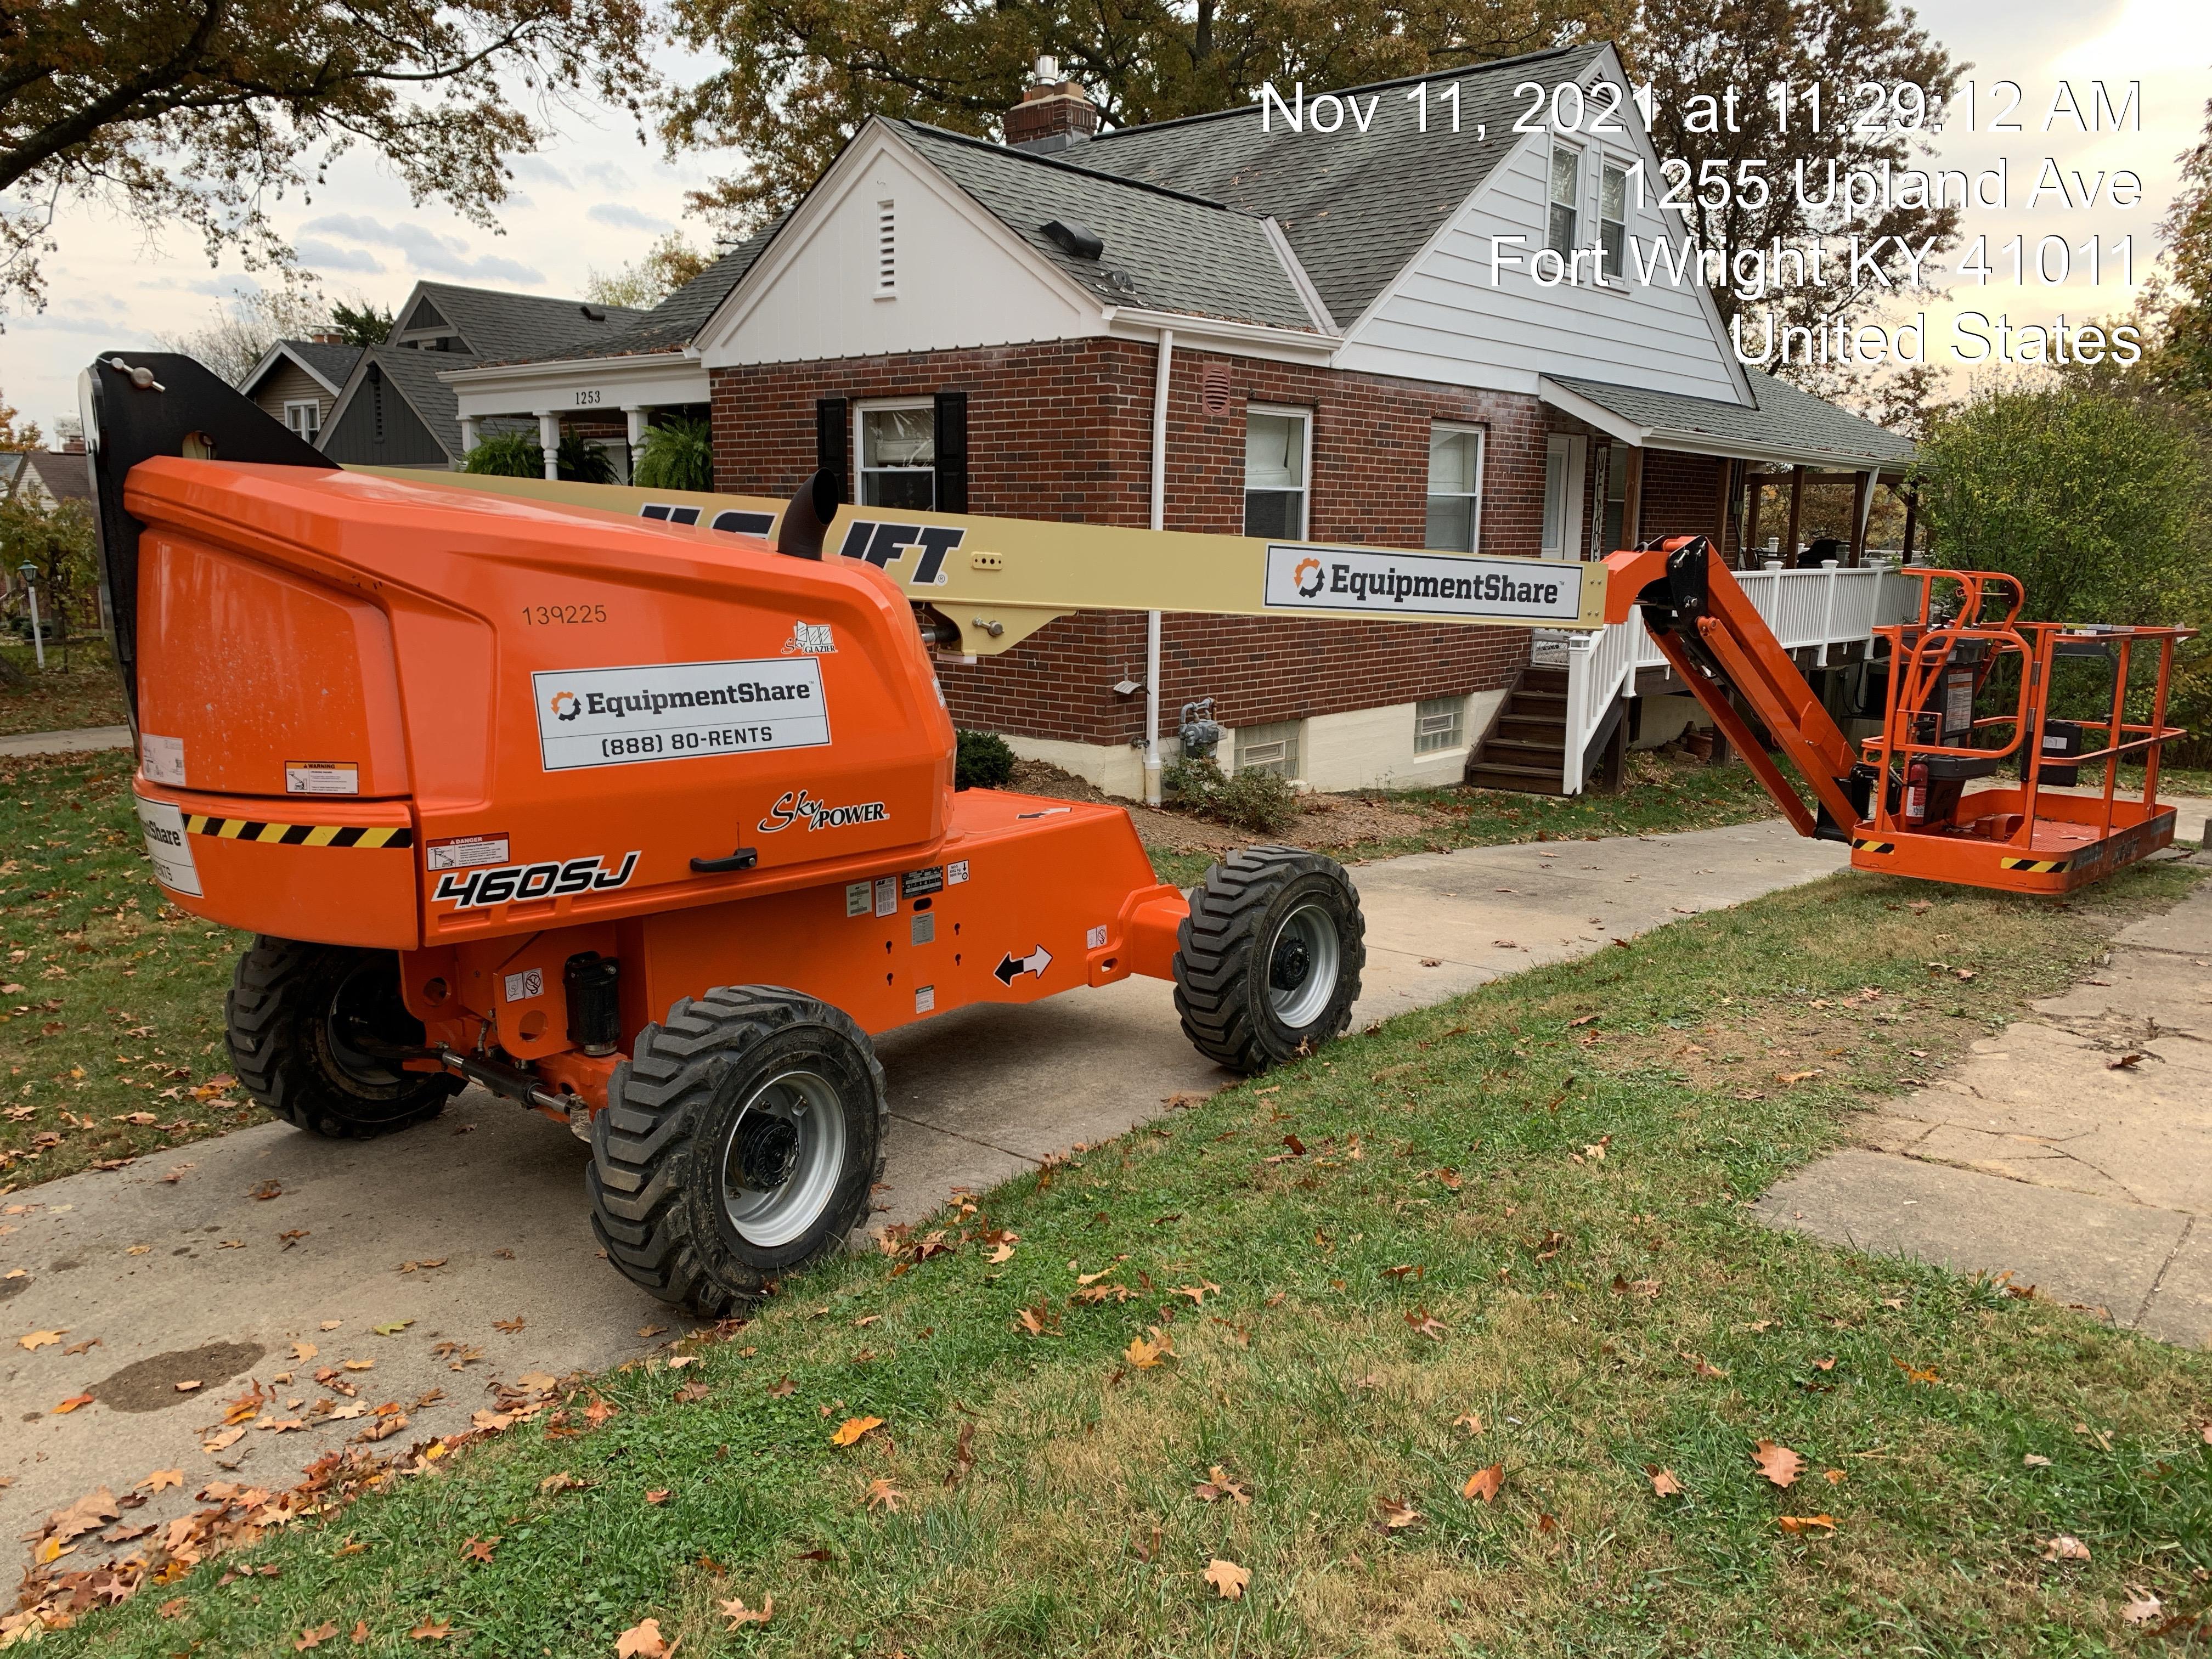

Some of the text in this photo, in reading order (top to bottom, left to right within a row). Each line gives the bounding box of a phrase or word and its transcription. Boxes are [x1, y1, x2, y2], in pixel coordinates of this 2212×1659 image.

[576, 391, 600, 404] 1253
[1593, 450, 1607, 562] WELCOME
[840, 521, 965, 583] IFT
[1330, 564, 1558, 603] EquipmentShare
[522, 605, 607, 625] 139225
[805, 645, 836, 653] GLAZIER
[586, 682, 810, 718] EquipmentShare
[602, 725, 772, 758] (888) 80-RENTS
[758, 790, 885, 831] Sky POWER
[455, 837, 483, 845] DANGER
[435, 854, 638, 908] 460SJ
